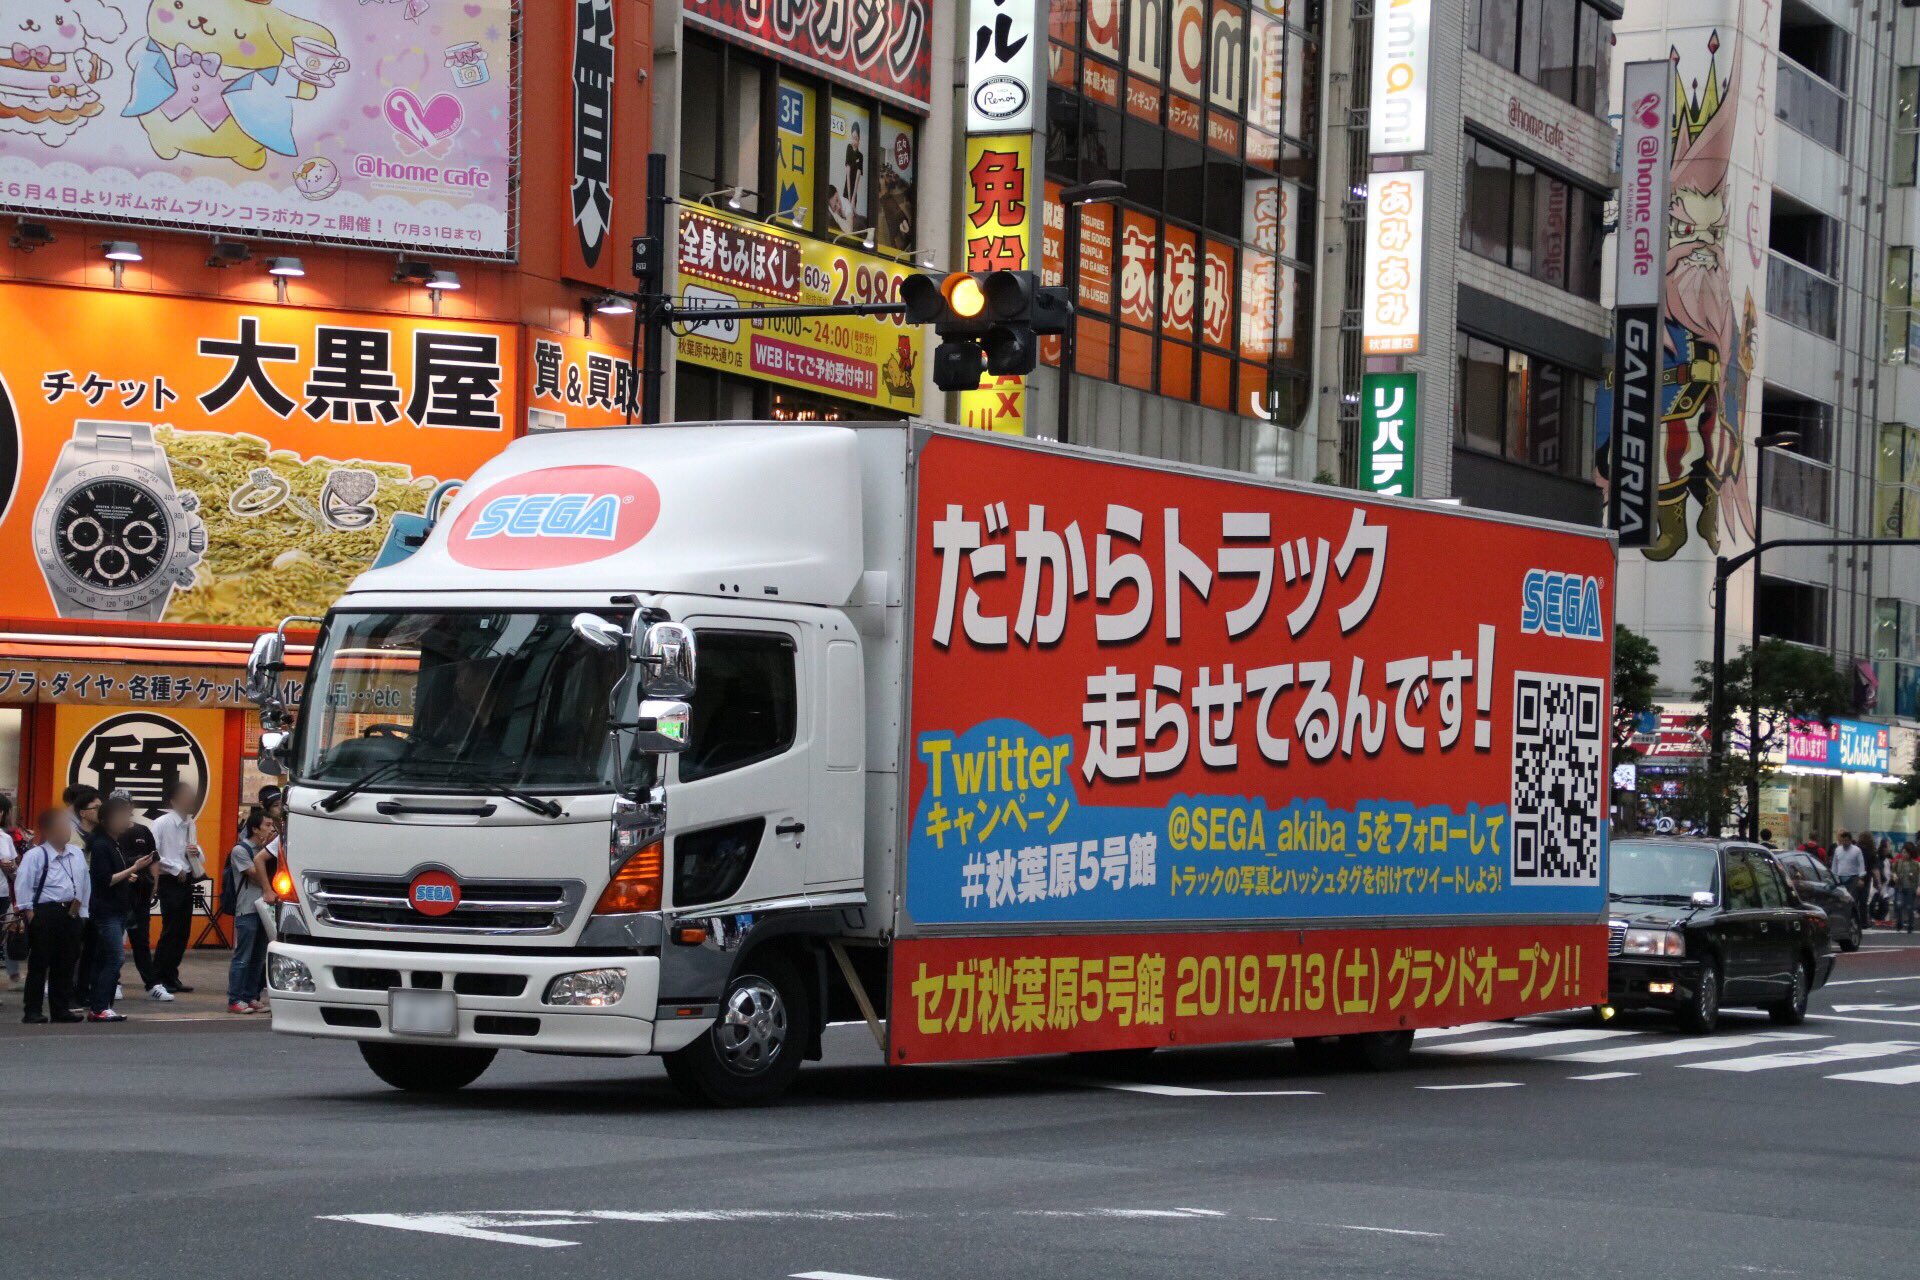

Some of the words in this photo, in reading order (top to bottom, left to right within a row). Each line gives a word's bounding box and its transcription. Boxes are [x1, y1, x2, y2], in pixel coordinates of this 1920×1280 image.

[975, 0, 1029, 63] ル
[1384, 0, 1416, 144] miami
[781, 94, 800, 125] 3F
[1168, 106, 1200, 131] ャラグッズ
[355, 154, 438, 184] @home
[443, 166, 491, 189] cafe
[1635, 136, 1660, 222] @home
[682, 220, 795, 290] 全身もみほぐし
[804, 265, 831, 294] 60分
[1376, 181, 1412, 326] あみあみ
[1633, 231, 1654, 276] cafe
[197, 316, 503, 432] 大黒屋
[754, 342, 783, 369] WEB
[42, 370, 180, 412] チケット
[1619, 318, 1650, 535] GALLERIA
[465, 493, 622, 541] SEGA
[931, 500, 1389, 648] だからトラック
[1520, 568, 1604, 642] SEGA
[1082, 623, 1496, 783] 走らせてるんです!
[87, 733, 193, 823] 質
[922, 735, 1070, 798] Twitter
[926, 791, 1071, 850] キャンペーン
[1168, 804, 1505, 858] @SEGA_akiba_5をフォローして
[415, 884, 455, 903] SEGA
[961, 831, 1158, 909] #秋葉原5号館
[1170, 863, 1503, 898] トラックの写真とハッシュタグを付けてツイートしよう!
[911, 952, 1166, 1036] セガ秋葉原5号館
[1175, 947, 1380, 1018] 2019.7.13(土)
[1387, 941, 1582, 1011] グランドオープン!!
